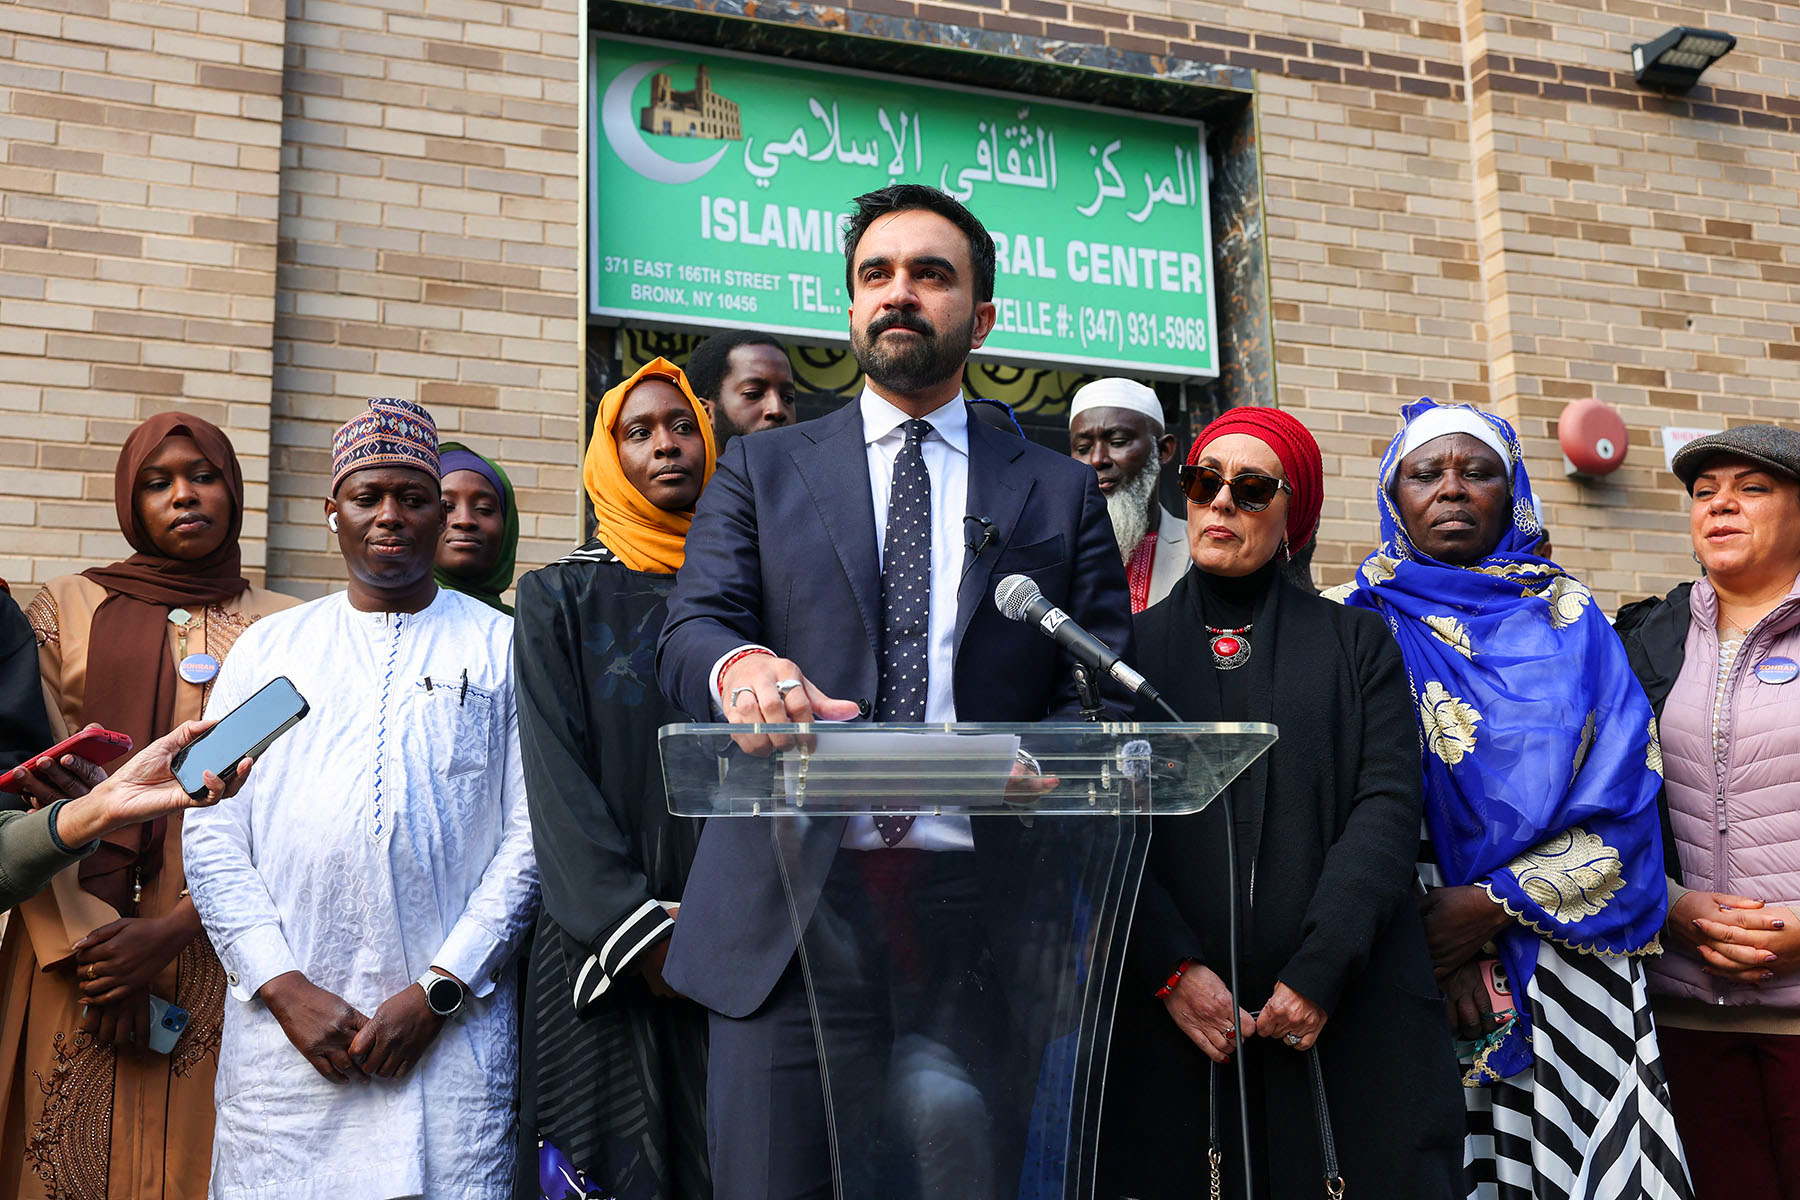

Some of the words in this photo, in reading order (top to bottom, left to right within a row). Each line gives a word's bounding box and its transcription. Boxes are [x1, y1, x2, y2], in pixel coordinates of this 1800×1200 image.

[743, 97, 923, 189] الإسلامي
[1076, 139, 1196, 223] المركز
[604, 256, 629, 275] 371
[633, 259, 673, 280] EAST
[677, 265, 721, 285] 166TH
[725, 269, 782, 291] STREET
[1067, 240, 1203, 295] CENTER
[631, 283, 689, 307] BRONX,
[693, 290, 713, 307] NY
[717, 293, 758, 313] 10456
[788, 273, 842, 315] TEL.:
[1056, 303, 1075, 339] #:
[1079, 305, 1124, 353] (347)
[1127, 311, 1207, 352] 931-5968
[1759, 664, 1796, 672] ZOHRAN
